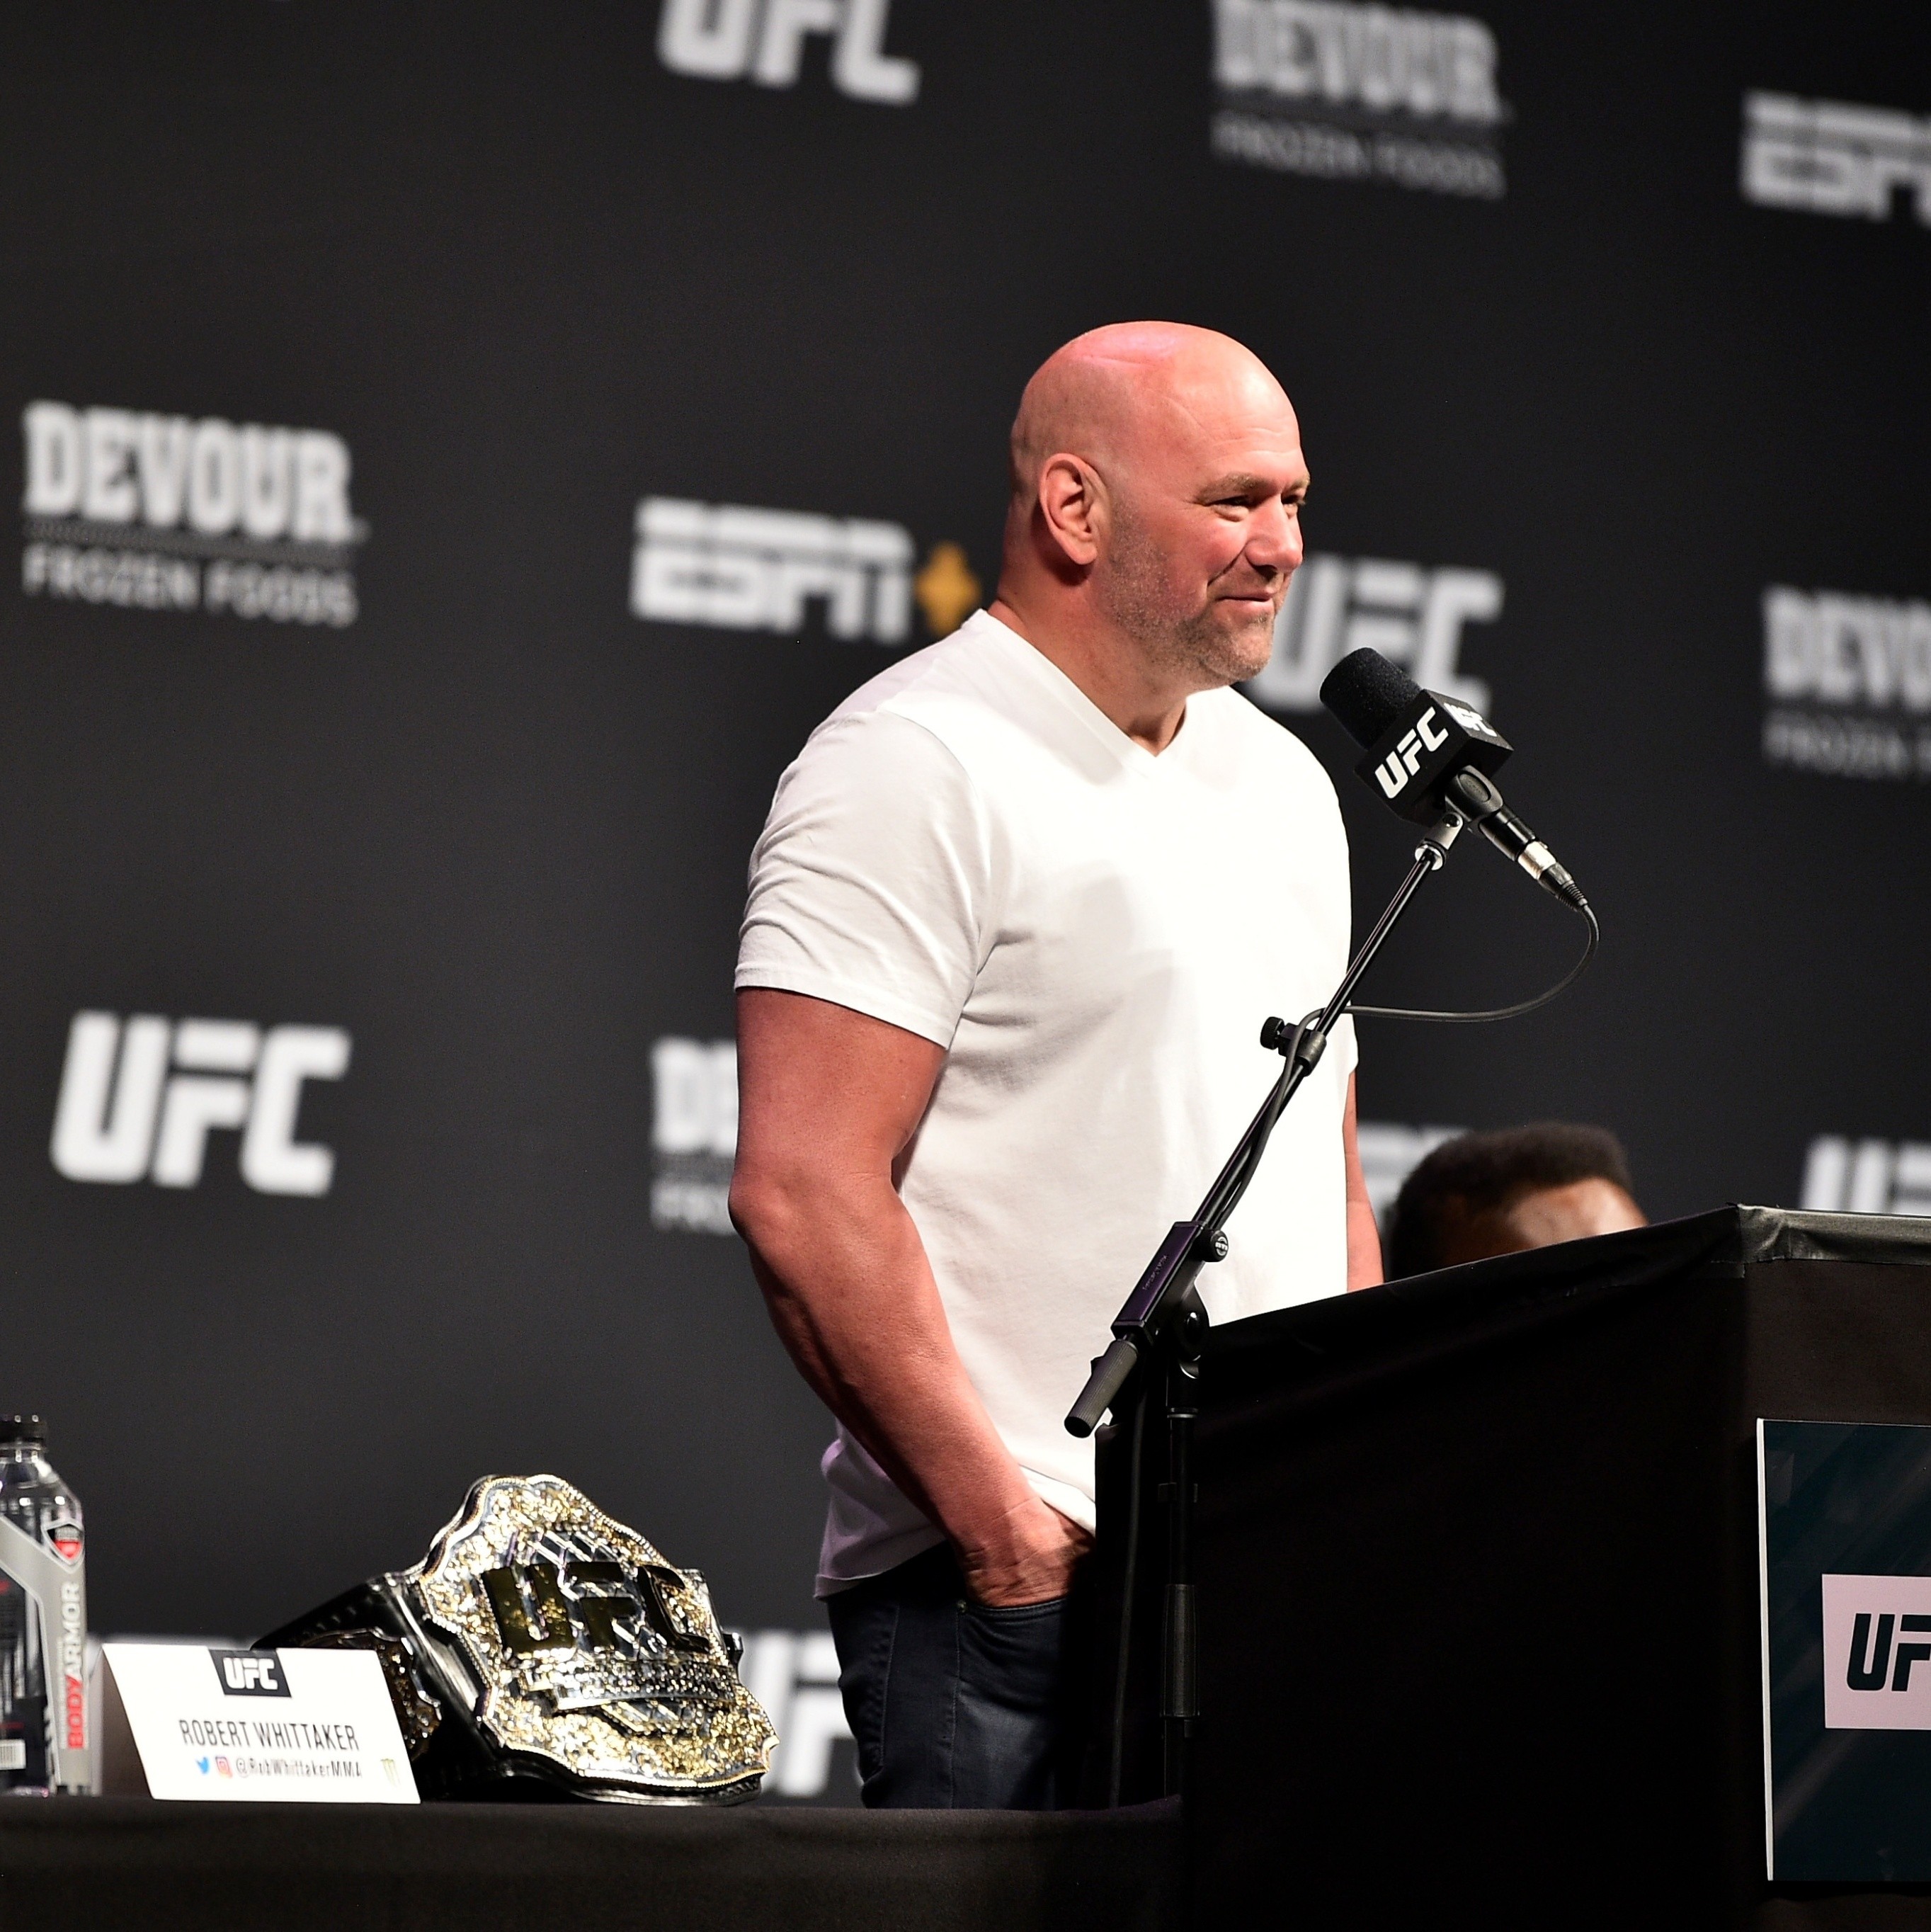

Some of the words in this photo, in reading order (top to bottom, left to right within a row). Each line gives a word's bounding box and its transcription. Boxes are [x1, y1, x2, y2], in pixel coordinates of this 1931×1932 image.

[1214, 0, 1497, 120] DEVOUR
[1743, 93, 1931, 221] ESP
[25, 401, 350, 540] DEVOUR
[25, 545, 198, 608] FROZEN
[206, 559, 356, 625] FOODS
[1251, 552, 1505, 717] UFC
[1375, 706, 1449, 799] UFC
[50, 1011, 352, 1197] UFC
[61, 1581, 84, 1750] BODYARMOR
[481, 1561, 713, 1659] UFC
[222, 1656, 280, 1691] UFC
[179, 1720, 250, 1747] ROBERT
[253, 1723, 360, 1751] WHITTAKER
